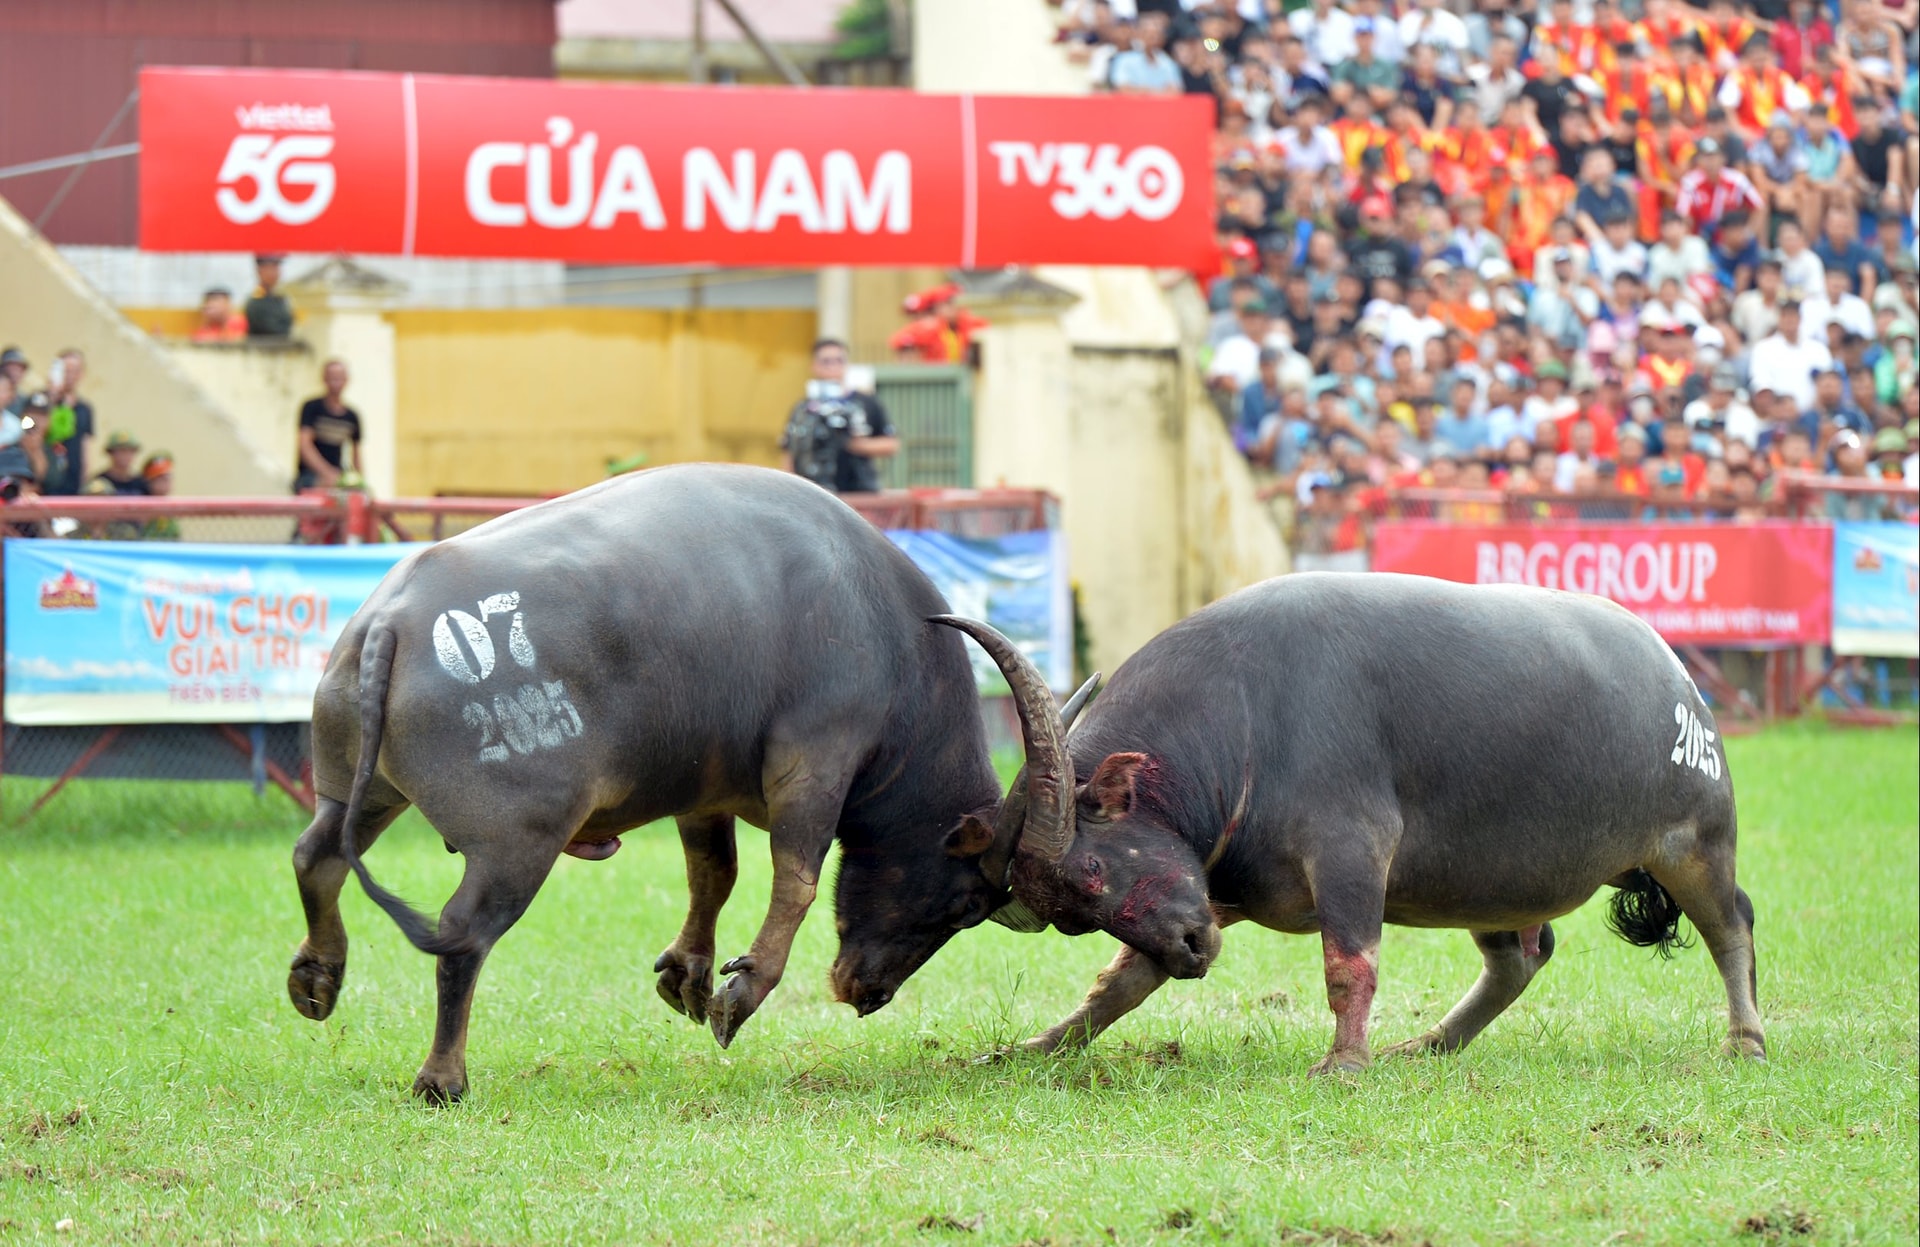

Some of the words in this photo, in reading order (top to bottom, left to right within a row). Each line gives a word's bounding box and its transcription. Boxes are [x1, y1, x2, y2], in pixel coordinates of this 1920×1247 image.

[235, 101, 335, 131] viettel
[215, 133, 337, 225] 5G
[464, 116, 668, 231] CỬA
[681, 147, 912, 234] NAM
[988, 140, 1185, 221] TV360
[143, 597, 218, 641] VUI
[228, 591, 329, 634] CHƠI
[432, 590, 536, 684] 07
[462, 680, 583, 763] 2025
[1670, 702, 1721, 781] 2025
